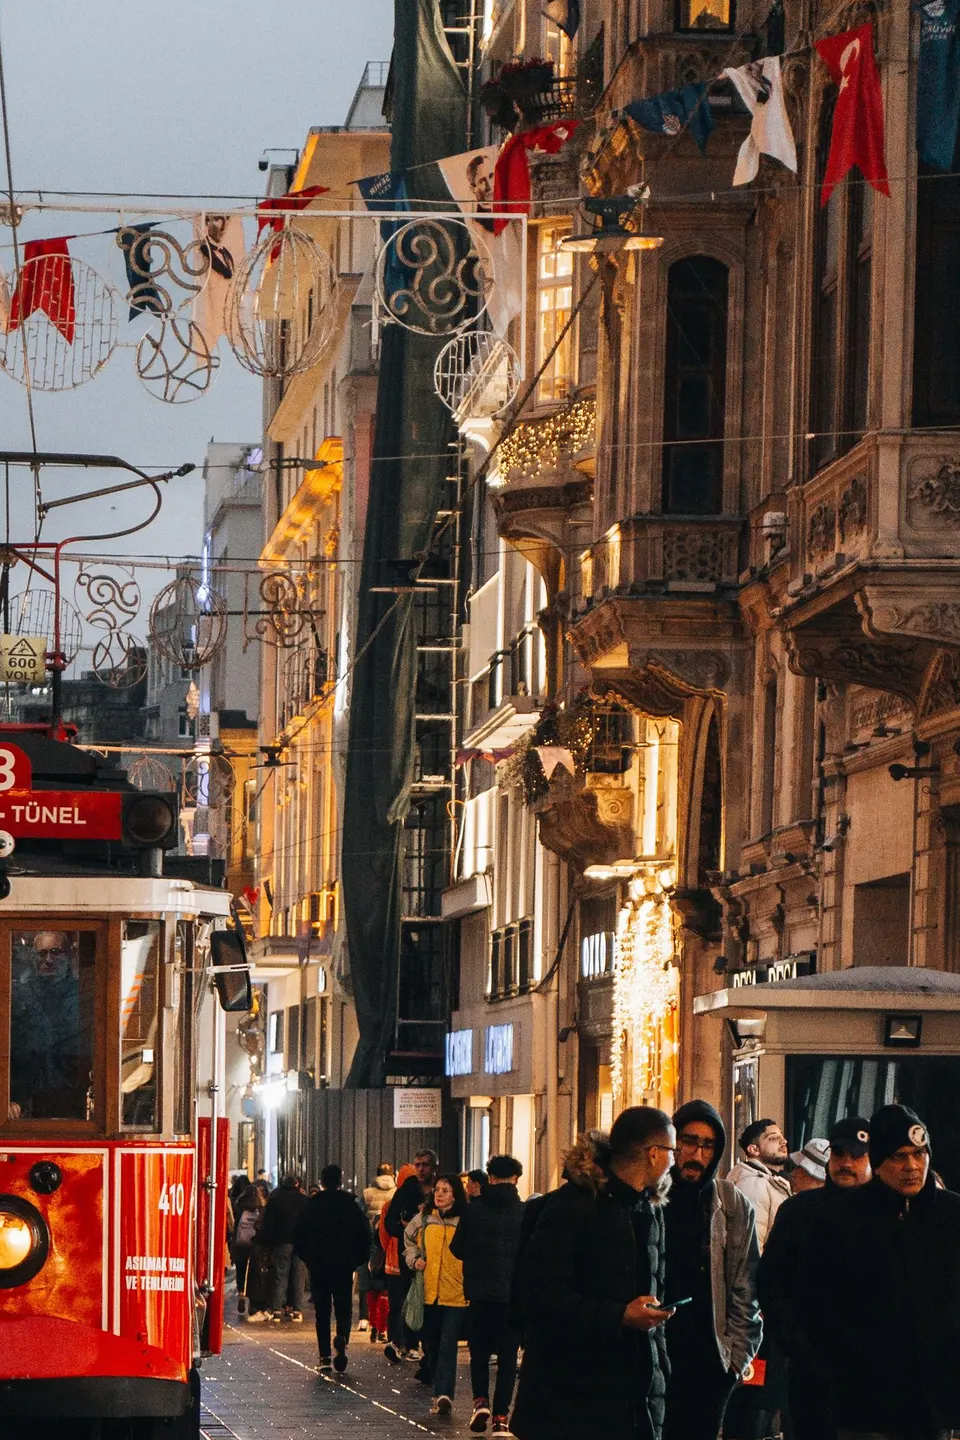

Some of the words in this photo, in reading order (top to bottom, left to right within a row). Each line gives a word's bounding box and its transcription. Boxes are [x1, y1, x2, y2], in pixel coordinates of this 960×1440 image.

[8, 657, 37, 669] 600
[5, 670, 39, 681] VOLT
[11, 801, 87, 825] TÜNEL
[158, 1182, 185, 1216] 410
[125, 1256, 168, 1272] ASILMAK
[125, 1275, 138, 1290] VE
